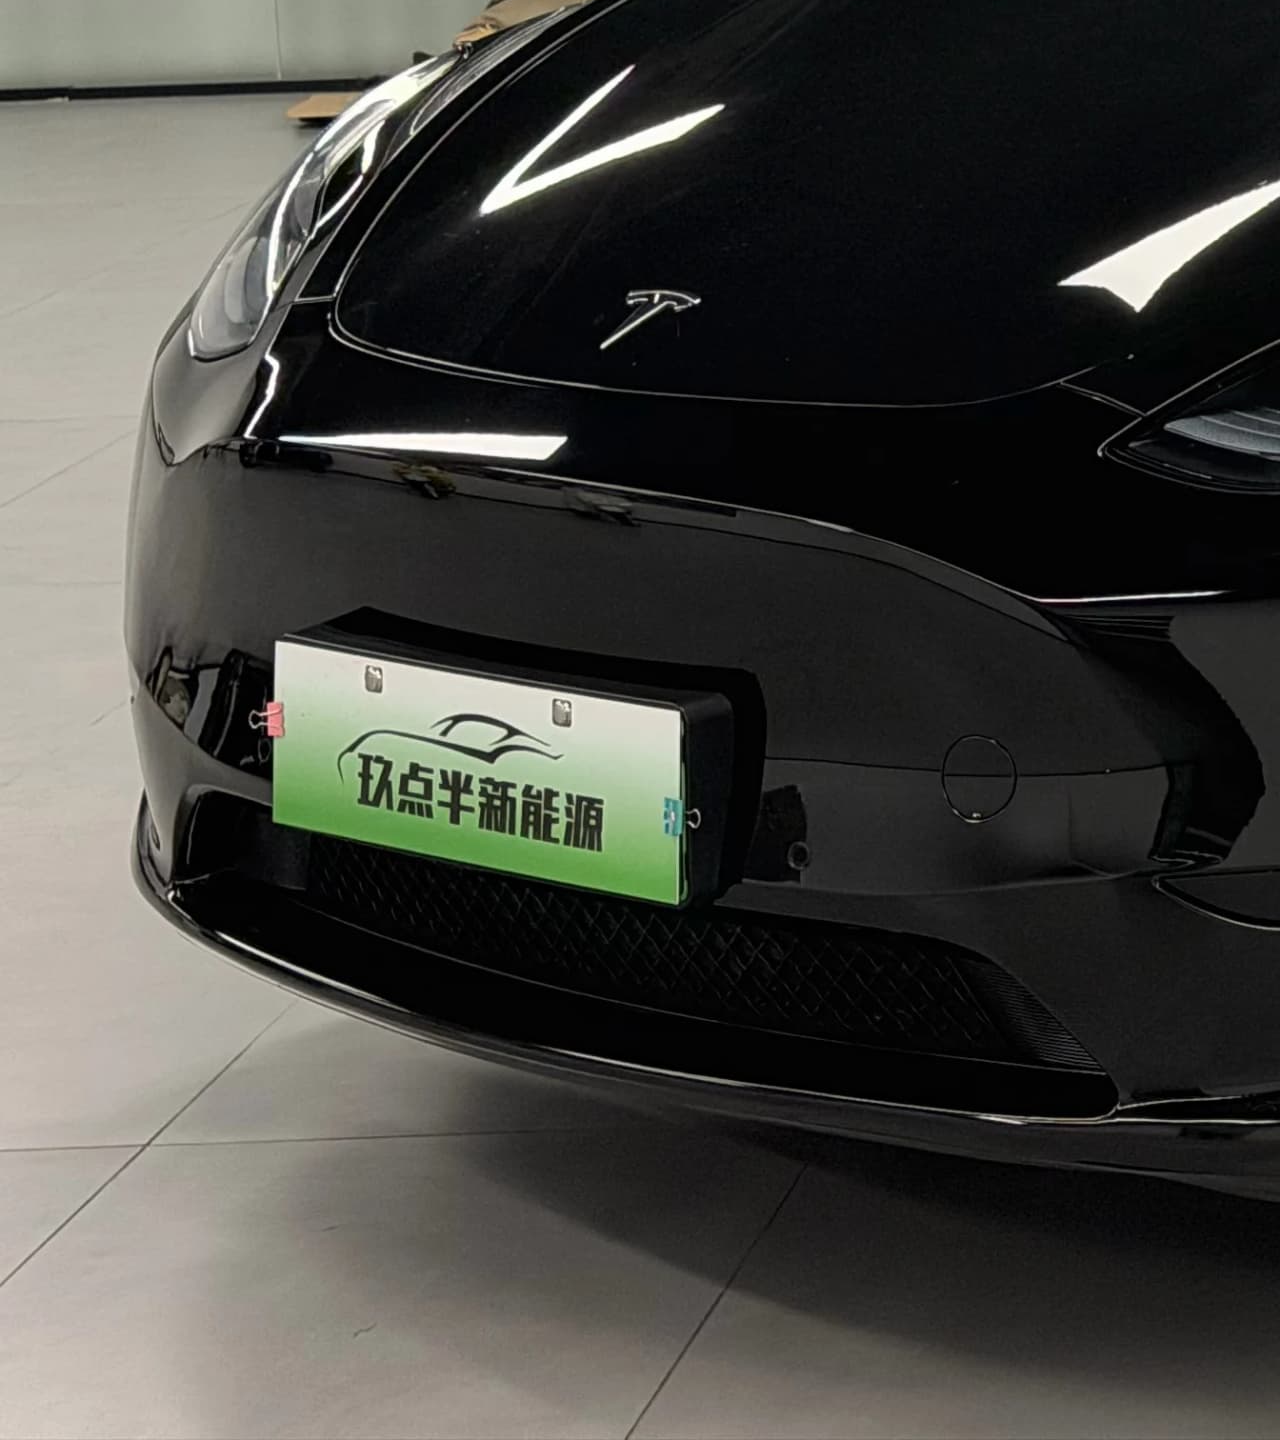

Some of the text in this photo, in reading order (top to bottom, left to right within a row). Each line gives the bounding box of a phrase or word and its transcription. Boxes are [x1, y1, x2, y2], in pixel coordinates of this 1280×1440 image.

[357, 752, 604, 852] 玖点半新能源
